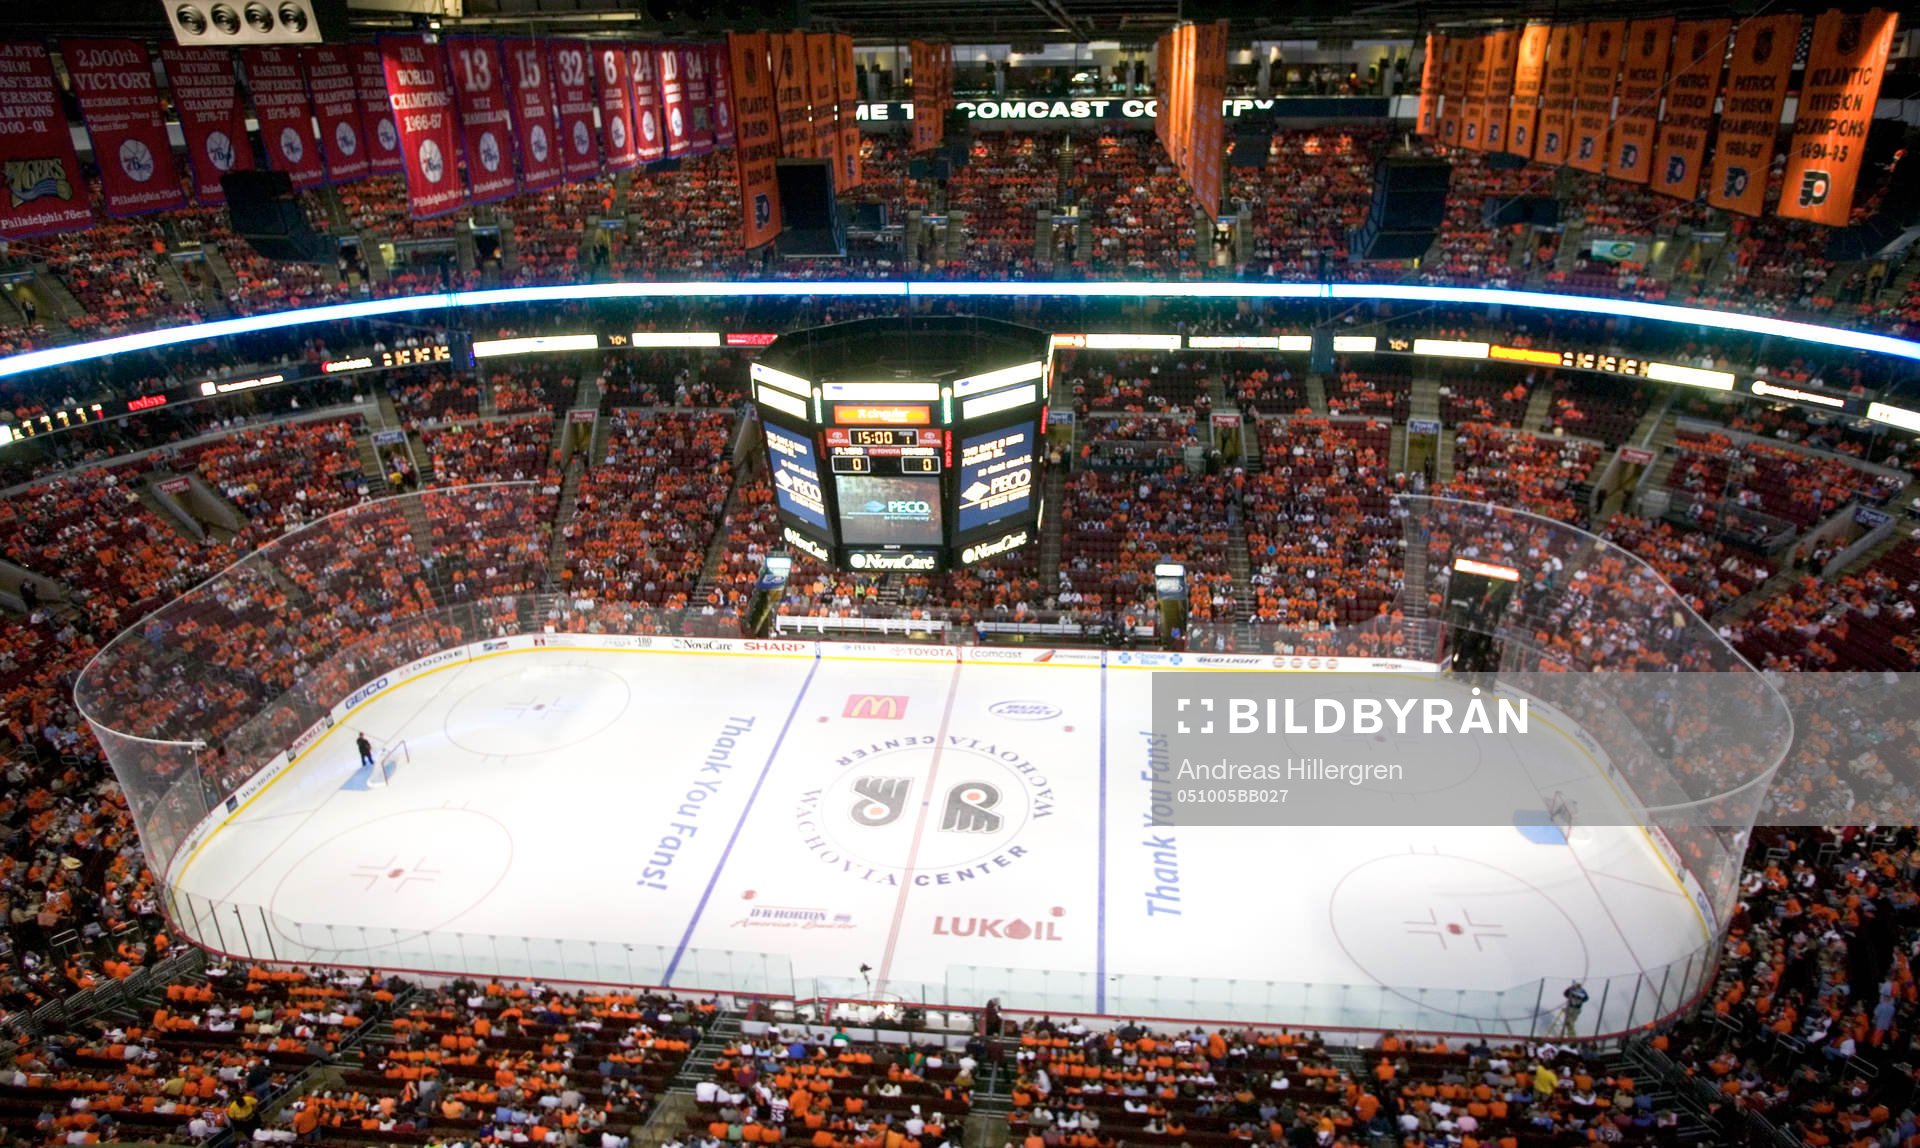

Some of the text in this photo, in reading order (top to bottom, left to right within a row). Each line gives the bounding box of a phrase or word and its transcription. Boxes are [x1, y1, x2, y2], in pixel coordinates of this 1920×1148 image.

[75, 49, 140, 68] 2,000th
[400, 46, 425, 63] NBA
[460, 47, 492, 92] 13
[514, 49, 541, 88] 15
[559, 50, 585, 86] 32
[603, 50, 618, 85] 6
[632, 50, 653, 82] 24
[661, 50, 678, 81] 10
[686, 50, 703, 81] 34
[72, 72, 153, 90] VICTORY
[397, 69, 435, 86] WORLD
[1810, 67, 1873, 87] ATLANTIC
[391, 90, 450, 110] CHAMPIONS
[955, 101, 1106, 119] COMCAST
[1809, 93, 1864, 111] DIVISION
[404, 113, 442, 133] 1966-67
[1792, 117, 1866, 138] CHAMPIONS
[858, 431, 893, 445] 15:00
[852, 458, 862, 471] 0
[922, 458, 932, 471] 0
[990, 468, 1032, 495] PECO
[887, 500, 930, 513] PECO
[790, 530, 829, 562] NovaCare
[972, 531, 1028, 562] NovaCare
[864, 553, 936, 569] NovaCare
[683, 638, 732, 652] NovaCare
[743, 641, 806, 652] SHARP
[907, 647, 954, 657] TOYOTA
[974, 649, 1022, 659] comcast
[412, 650, 463, 671] DODGE
[1133, 651, 1167, 660] Choose
[1140, 658, 1159, 666] Blue
[344, 677, 389, 710] GEICO
[835, 734, 1055, 821] WACHOVIA CENTER
[636, 716, 756, 891] Thank You Fans!
[1139, 730, 1182, 917] Thank You Fans!
[796, 787, 1029, 888] WACHOVIA CENTER
